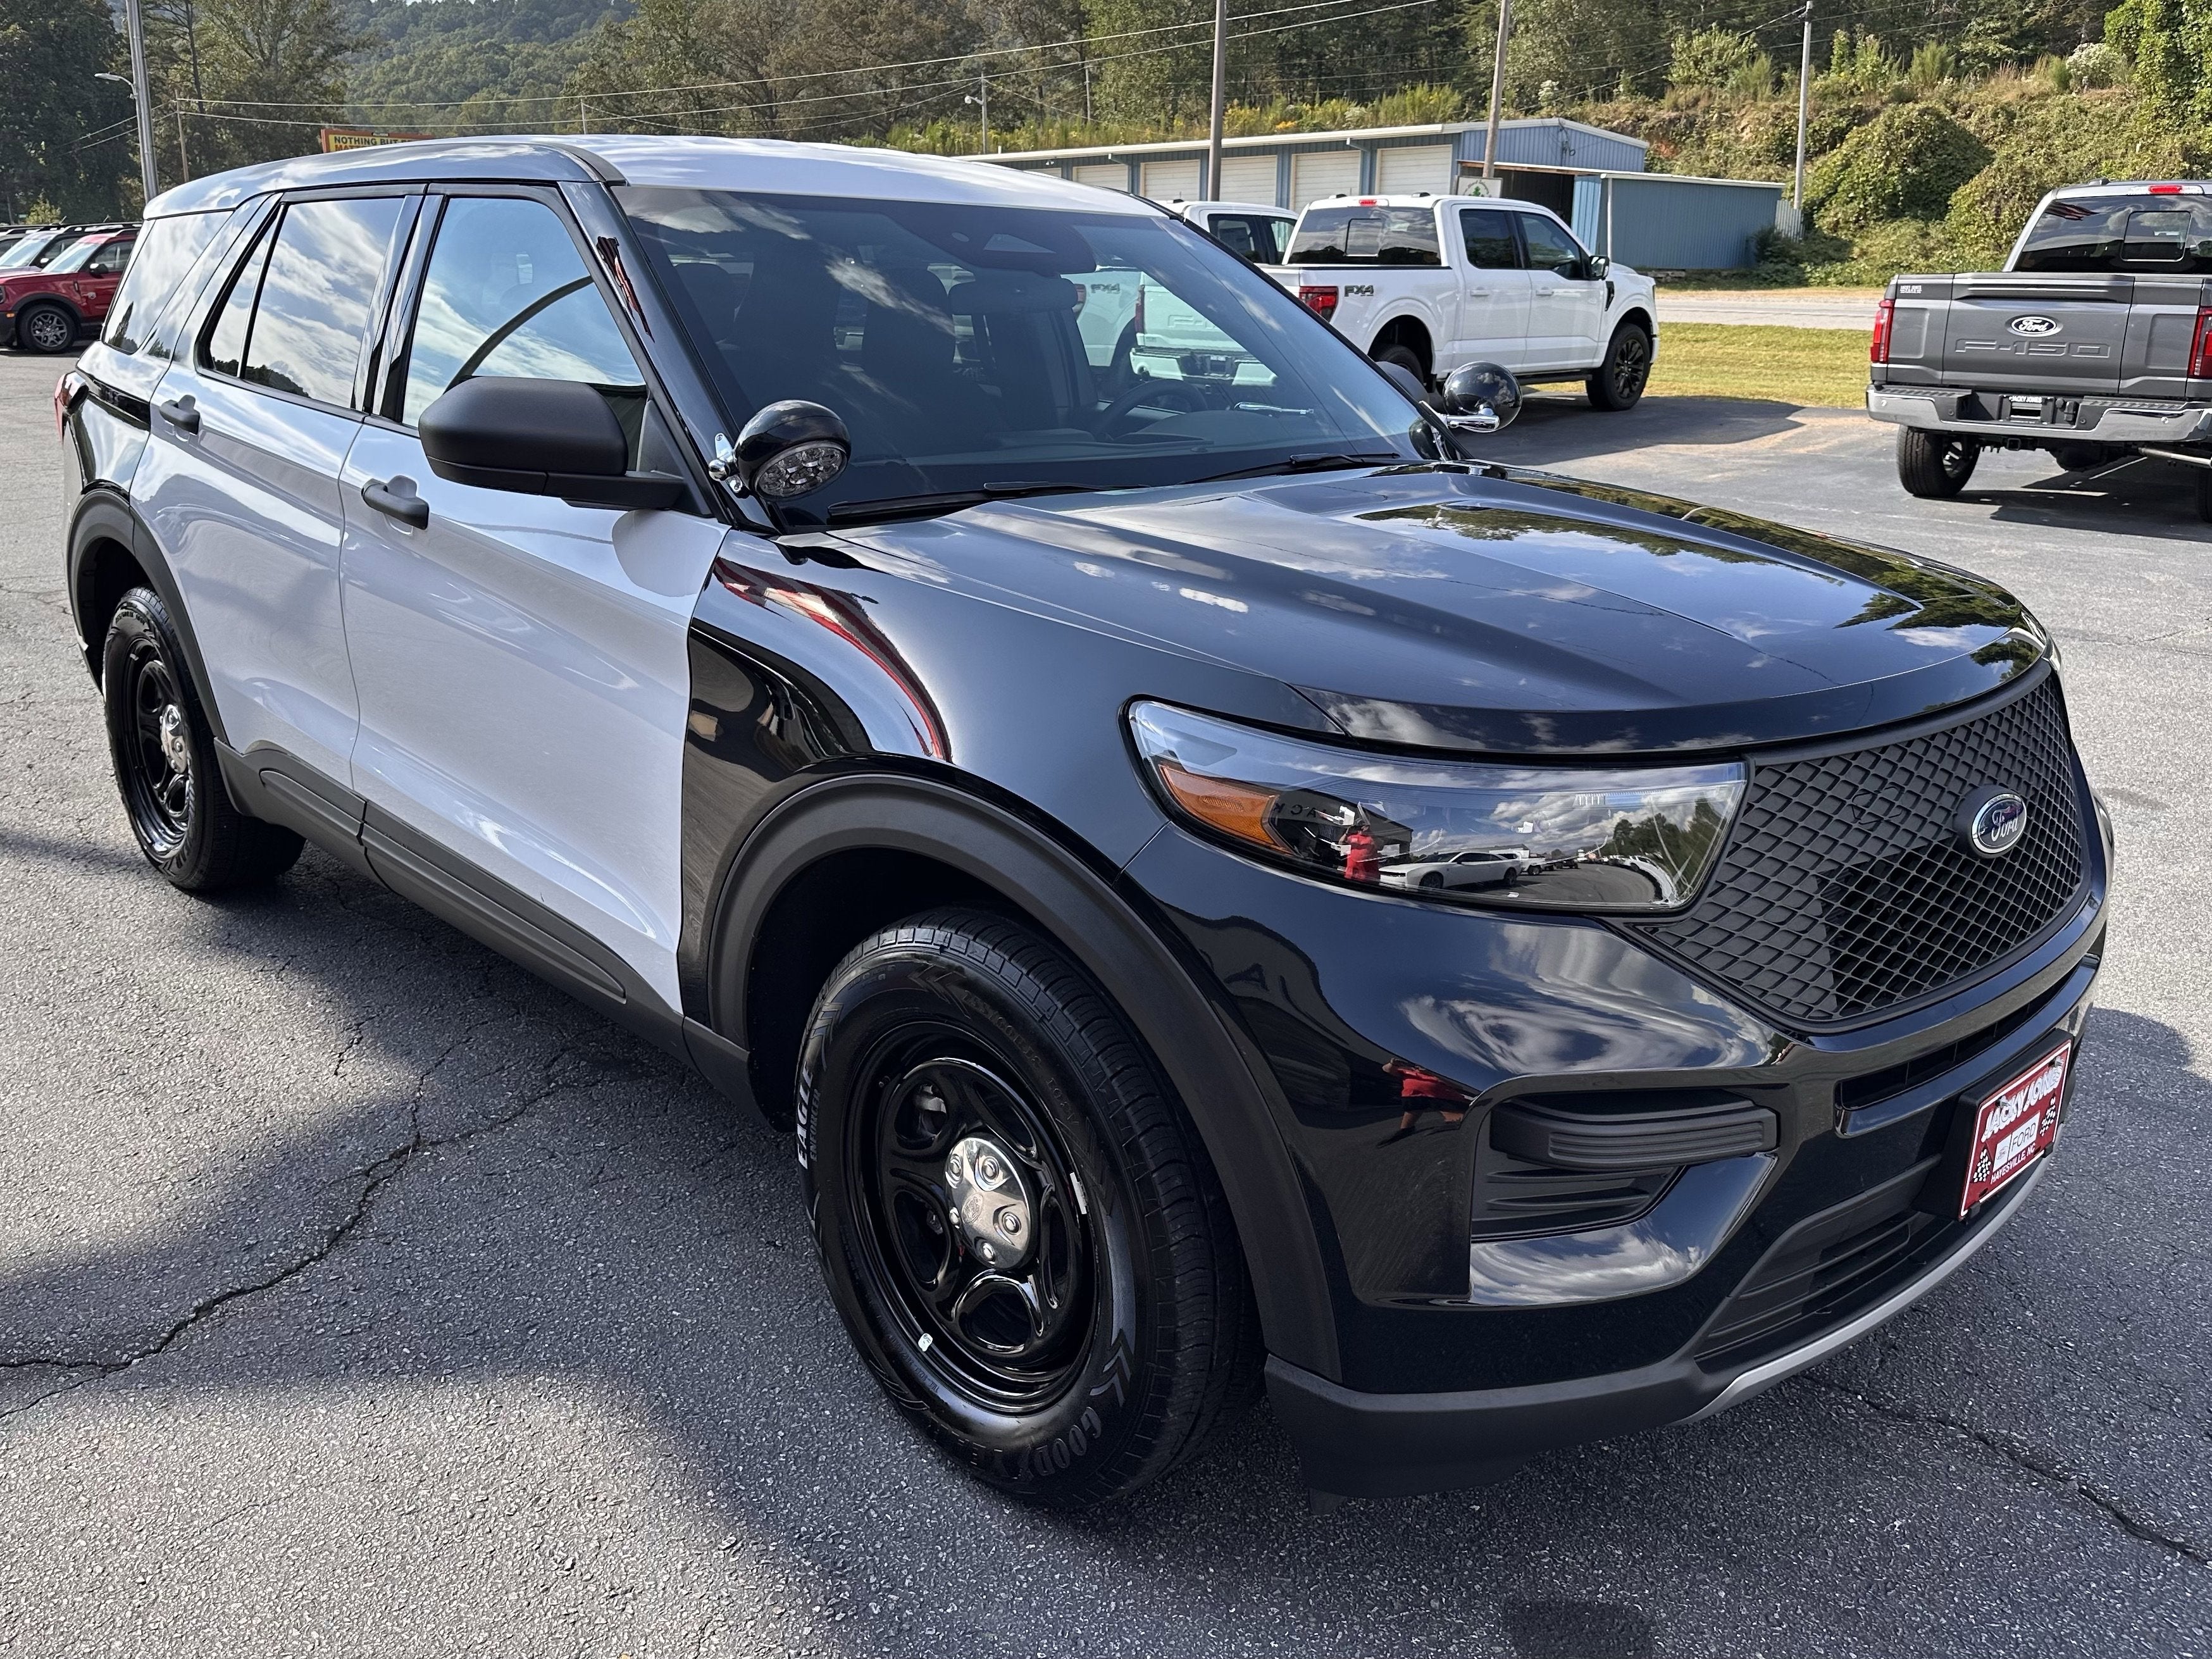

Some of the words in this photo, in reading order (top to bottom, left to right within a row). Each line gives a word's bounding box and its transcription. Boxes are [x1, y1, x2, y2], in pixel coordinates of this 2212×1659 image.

[334, 136, 377, 146] NOTHING
[1091, 283, 1121, 294] FX4
[1345, 285, 1374, 297] FX4
[2018, 319, 2049, 332] Ford
[1954, 338, 2111, 359] F-150
[1991, 805, 2019, 842] Ford
[797, 1060, 813, 1170] EAGLE
[1980, 1085, 2029, 1143] JACKY
[2023, 1066, 2063, 1112] JONES
[809, 1088, 821, 1162] ENFORCER
[2011, 1122, 2036, 1152] FORD
[1990, 1150, 2027, 1185] HAYESVILLE,
[2026, 1142, 2036, 1157] NC
